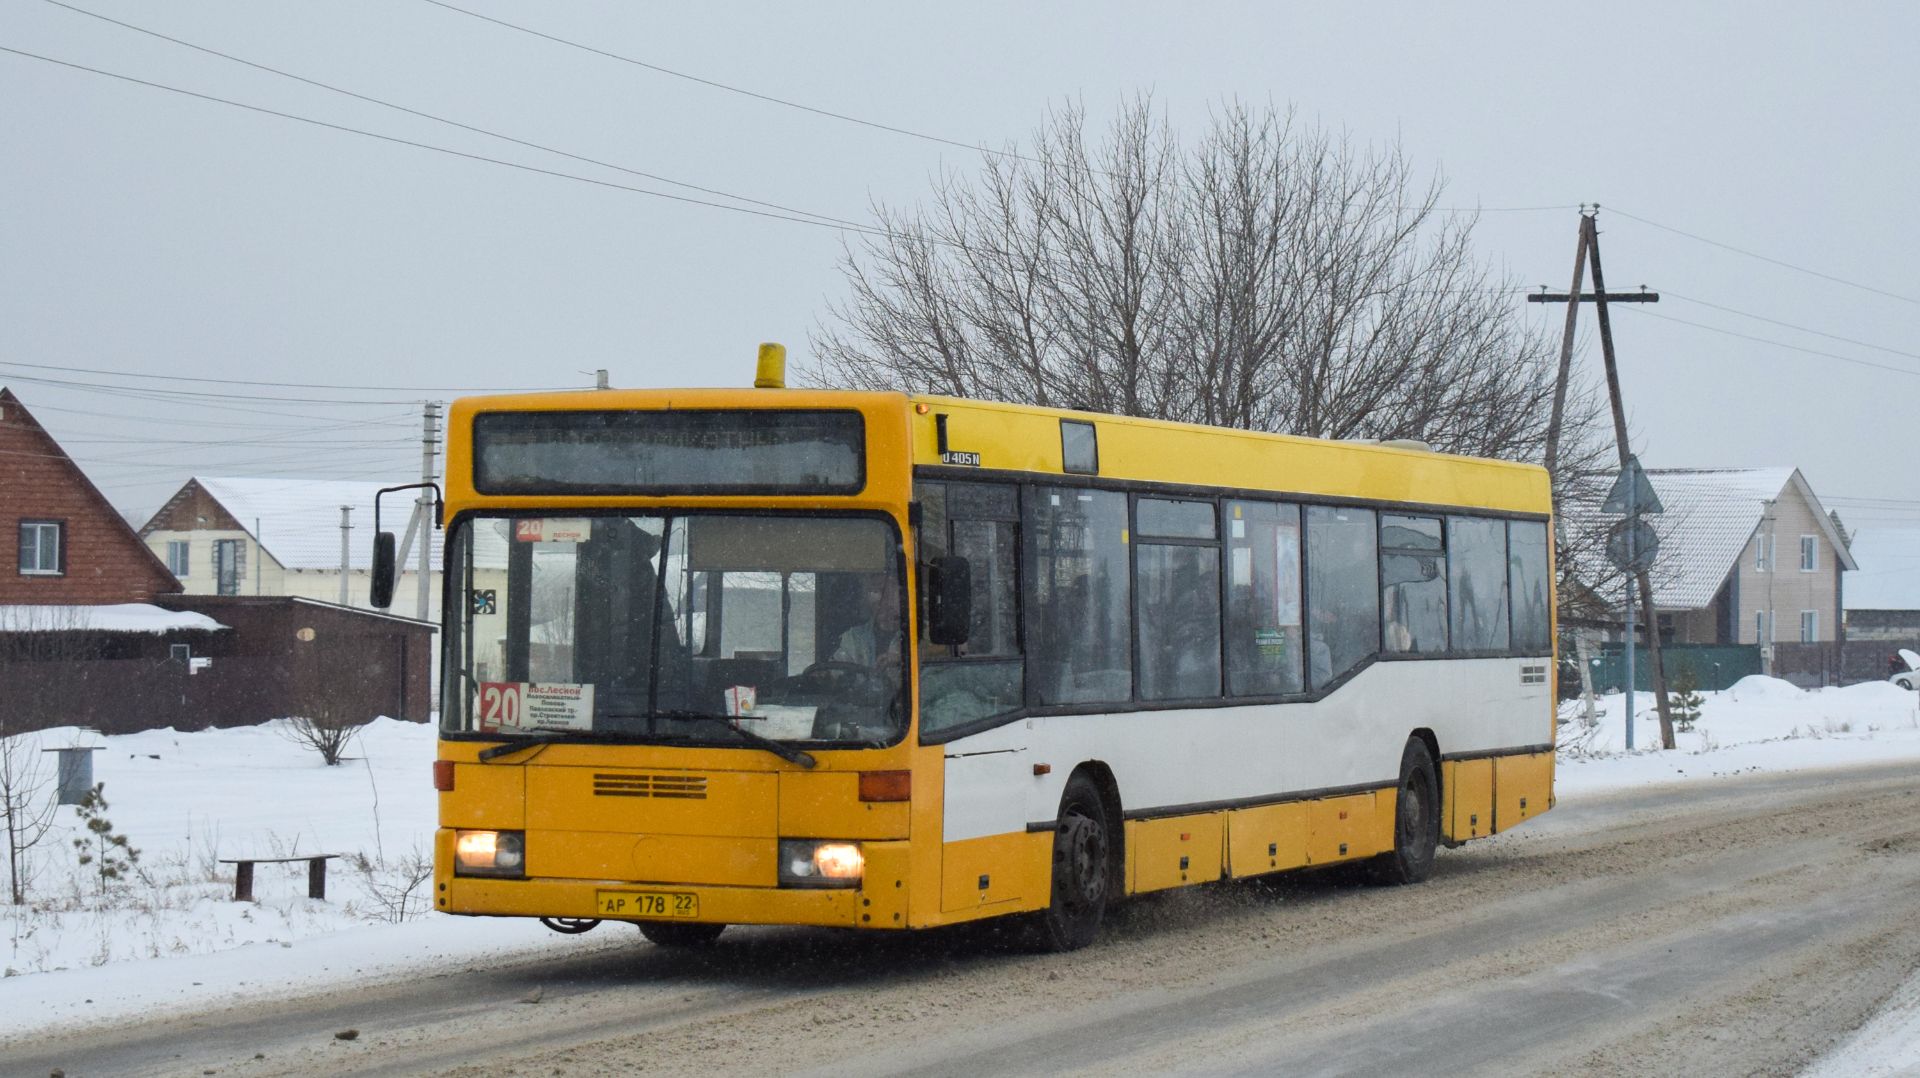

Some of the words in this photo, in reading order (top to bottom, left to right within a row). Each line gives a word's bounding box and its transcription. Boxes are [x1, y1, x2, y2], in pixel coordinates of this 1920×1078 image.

[519, 520, 541, 535] 20
[485, 687, 519, 727] 20
[606, 899, 625, 912] АР
[635, 895, 665, 913] 178
[675, 895, 692, 910] 22
